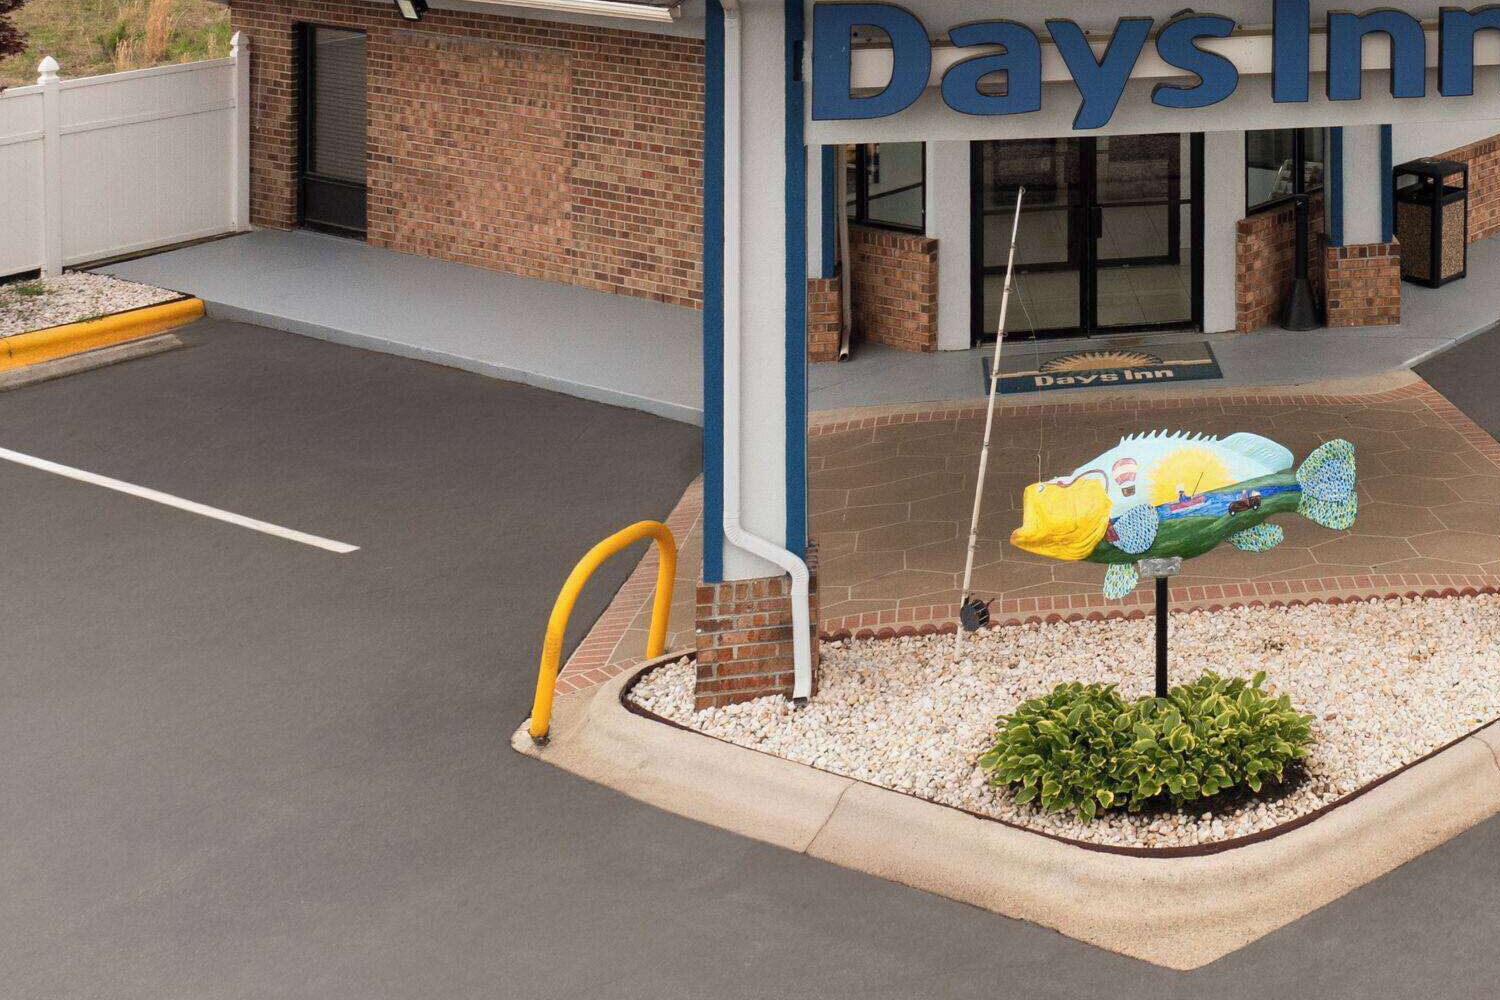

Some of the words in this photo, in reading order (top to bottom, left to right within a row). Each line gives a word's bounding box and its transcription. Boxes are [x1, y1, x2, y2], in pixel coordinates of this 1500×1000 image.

[811, 0, 1240, 131] Days
[1034, 372, 1119, 387] Days
[1123, 368, 1174, 381] Inn
